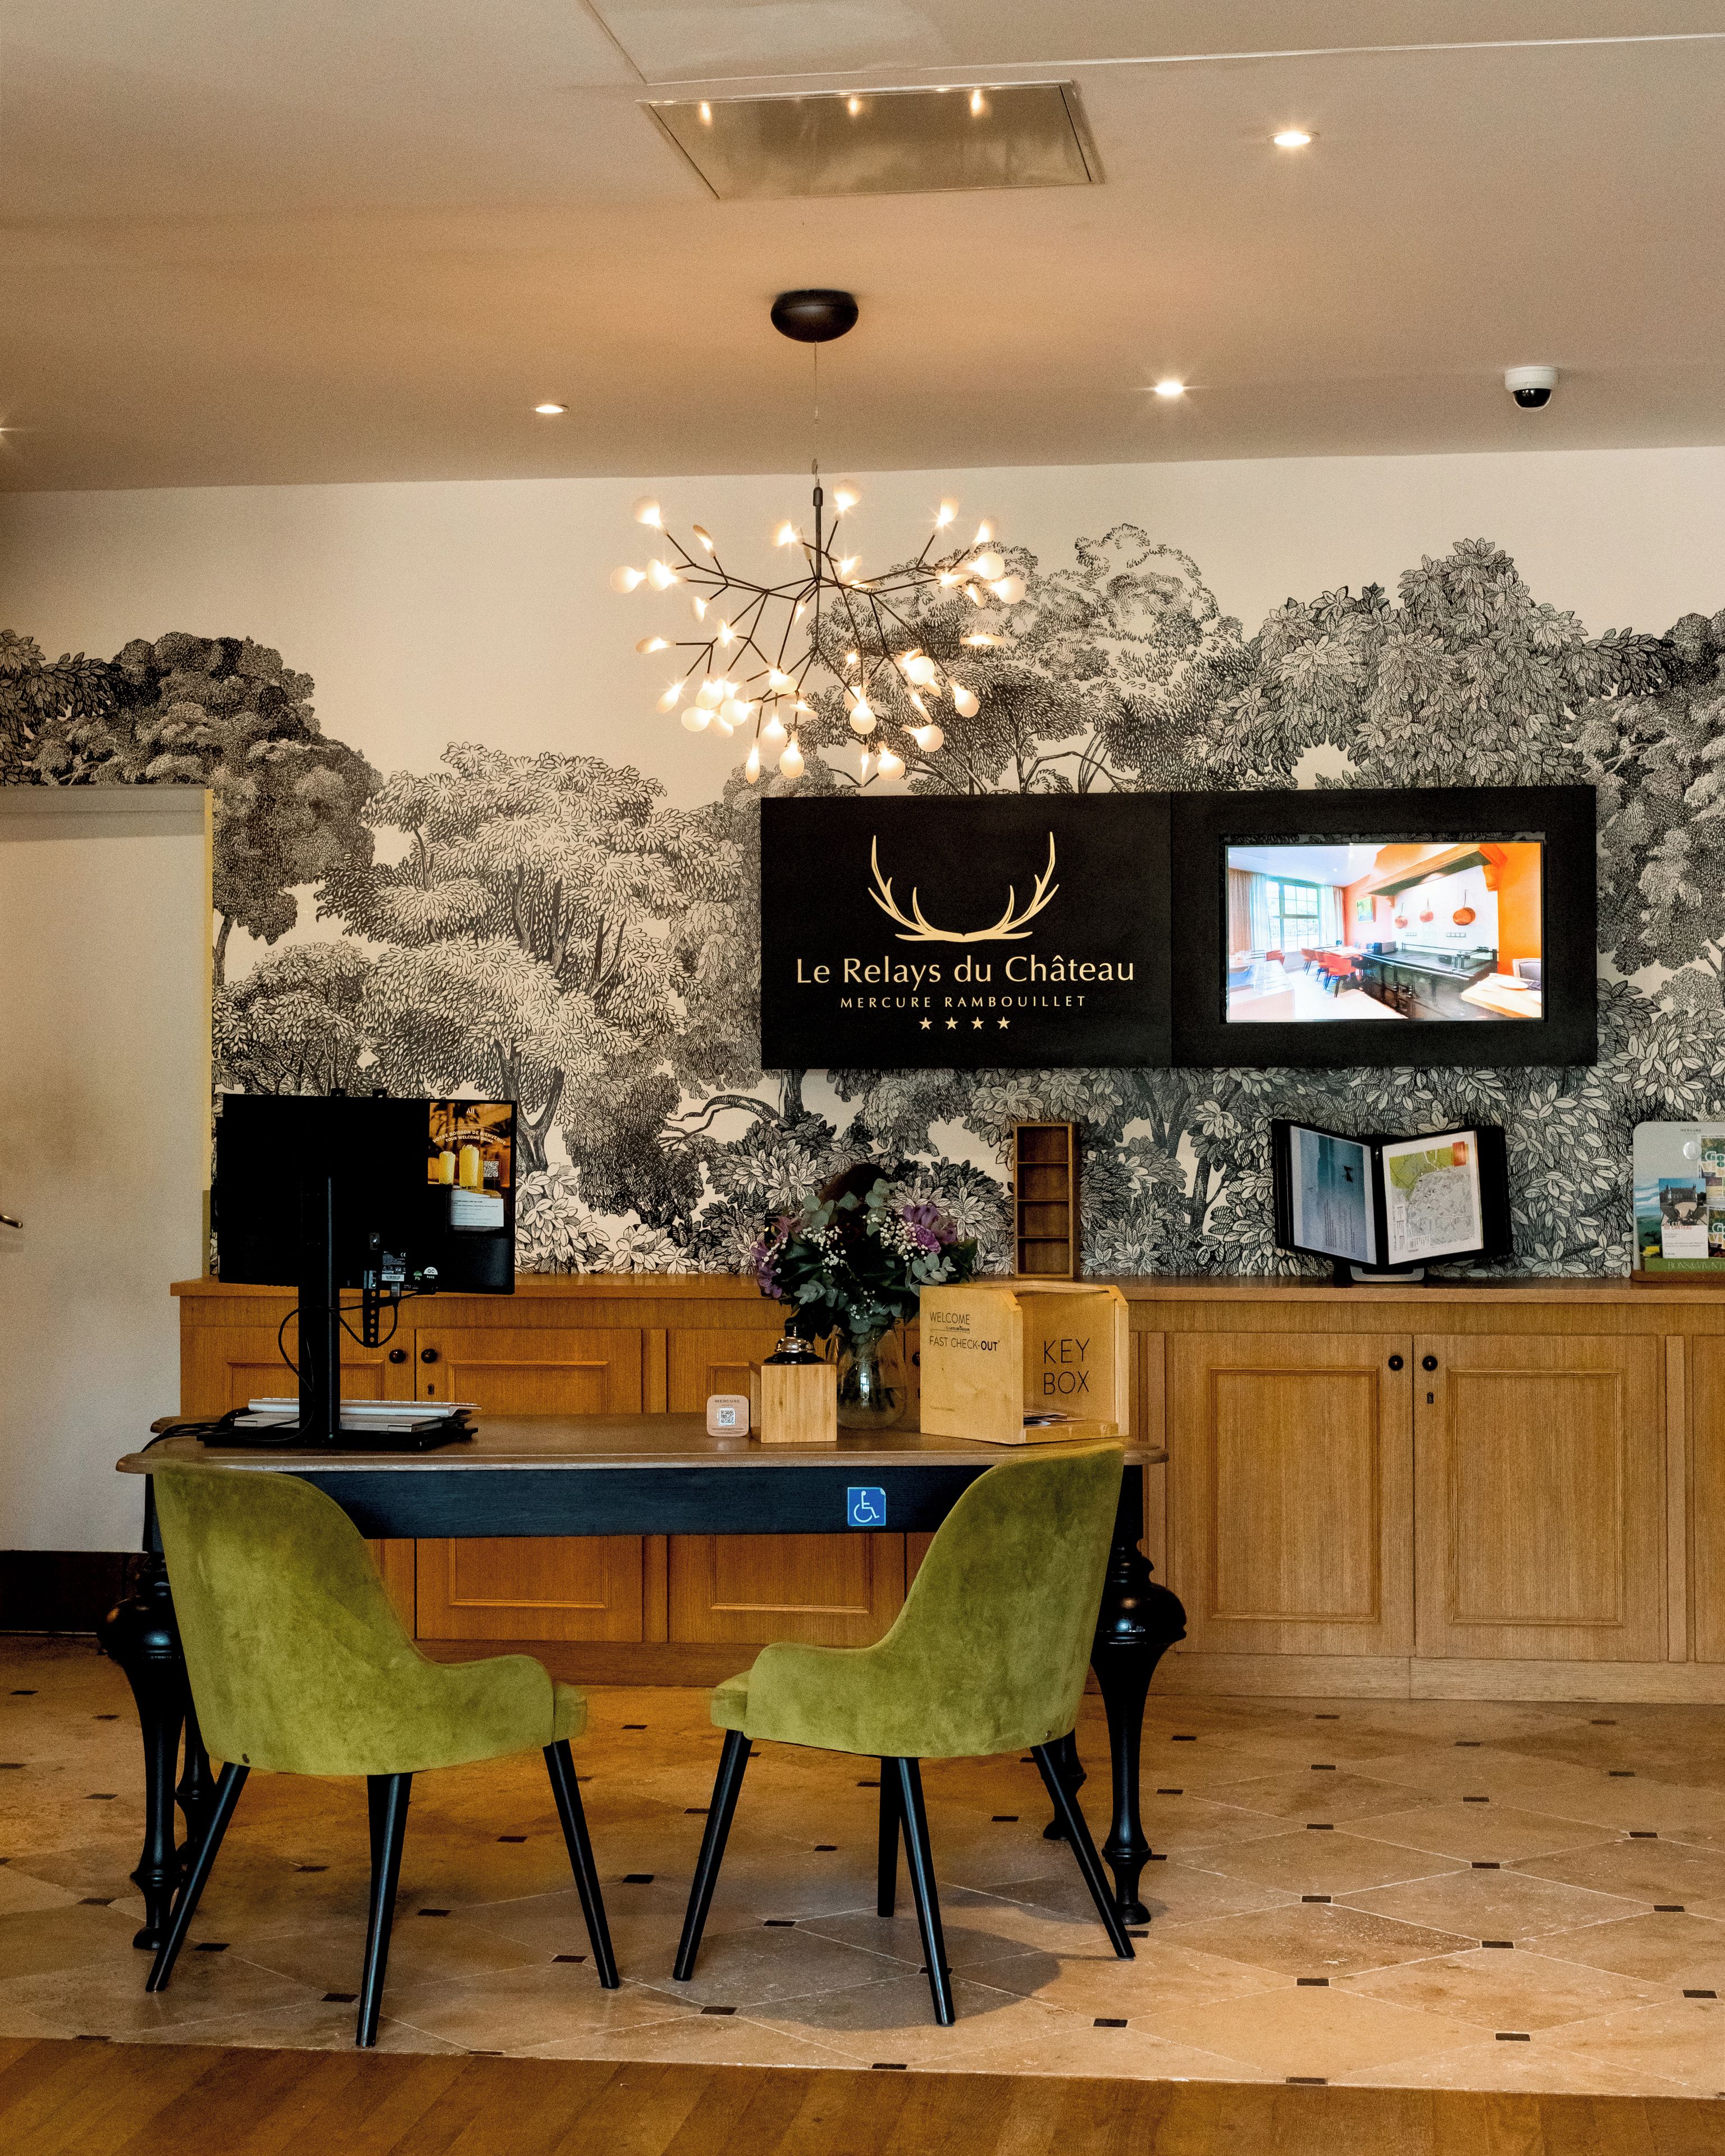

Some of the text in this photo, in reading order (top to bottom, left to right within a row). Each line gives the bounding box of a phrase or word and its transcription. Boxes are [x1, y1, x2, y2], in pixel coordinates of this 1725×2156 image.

[797, 954, 1134, 991] Le Relays du Château
[841, 995, 1085, 1008] MERCURE RAMBOUILLET
[432, 1132, 449, 1143] VOTRE
[480, 1131, 506, 1145] BIENVENUE
[929, 1311, 970, 1324] WELCOME
[929, 1336, 948, 1347] FAST
[1044, 1338, 1090, 1364] KEY
[1044, 1371, 1089, 1395] BOX
